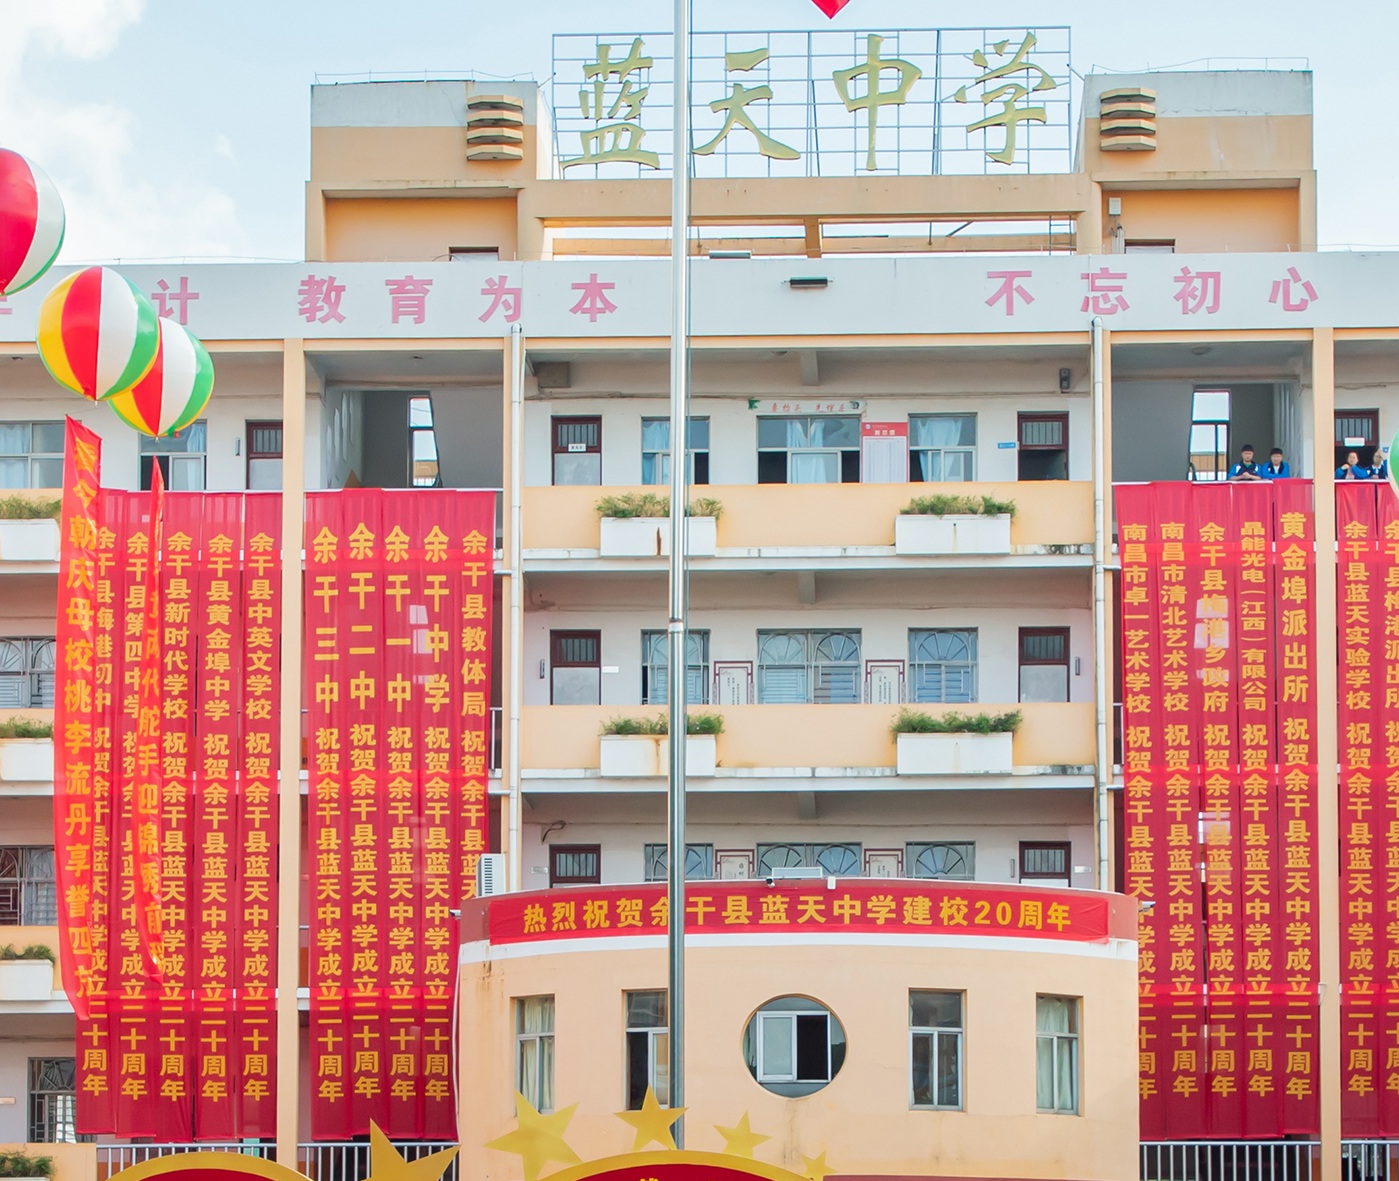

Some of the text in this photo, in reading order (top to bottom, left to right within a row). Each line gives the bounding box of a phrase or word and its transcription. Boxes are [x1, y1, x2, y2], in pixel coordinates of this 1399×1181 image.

[297, 272, 618, 325] 教育为本
[560, 32, 1056, 171] 蓝天中学
[984, 264, 1320, 316] 不忘初心
[159, 532, 193, 1101] 余干县新时代学校 祝贺余干县蓝天中学成立二十周年
[201, 534, 234, 1102] 余干县黄金埠中学 祝贺余干县蓝天中学成立二十周年
[243, 532, 275, 1101] 余干县中英文学校 祝贺余干县蓝天中学成立二十周年
[312, 527, 344, 1102] 余干三中 祝贺余干县蓝天中学成立二十周年
[348, 522, 380, 1098] 余干二中 祝贺余干县蓝天中学成立二十周年
[385, 525, 416, 1101] 余干一中 祝贺余干县蓝天中学成立二十周年
[423, 525, 450, 1101] 余干中学 祝贺余干县蓝天中学成立二十周年
[461, 530, 488, 717] 余干县教体局
[1121, 523, 1158, 1100] 南昌市卓一艺术学校 祝贺余干县蓝天中学成立二十周年
[1159, 521, 1198, 1098] 南昌市清北艺术学校 祝贺余干县蓝天中学成立二十周年
[1199, 521, 1237, 1098] 余干县梅港乡政府 祝贺余干县蓝天中学成立二十周年
[1280, 511, 1312, 1100] 黄金埠派出所 祝贺余干县蓝天中学成立二十周年
[1344, 520, 1374, 1097] 余干县蓝天实验学校 祝贺余干县蓝天中学成立二十周年
[522, 894, 1072, 934] 热烈祝贺余干县蓝天中学建校20周年
[1242, 723, 1275, 1097] 祝贺余干县蓝天中学成立二十周年
